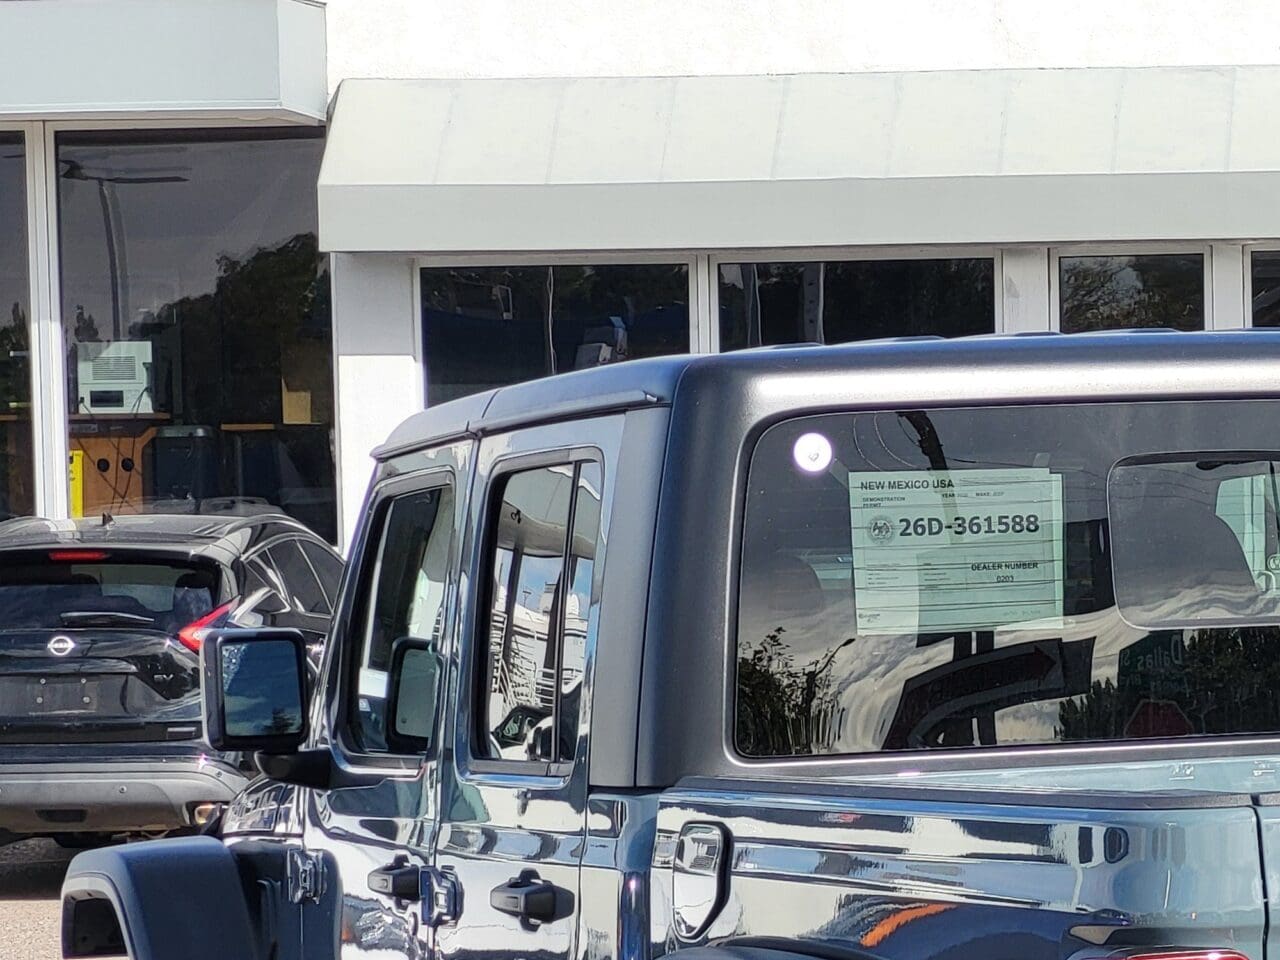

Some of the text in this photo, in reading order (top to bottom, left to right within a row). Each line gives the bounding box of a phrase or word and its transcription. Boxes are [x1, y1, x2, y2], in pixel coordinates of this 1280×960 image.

[860, 479, 955, 490] NEW MEXICO USA
[899, 514, 1040, 537] 26D-361588
[971, 561, 1039, 571] DEALER NUMBER
